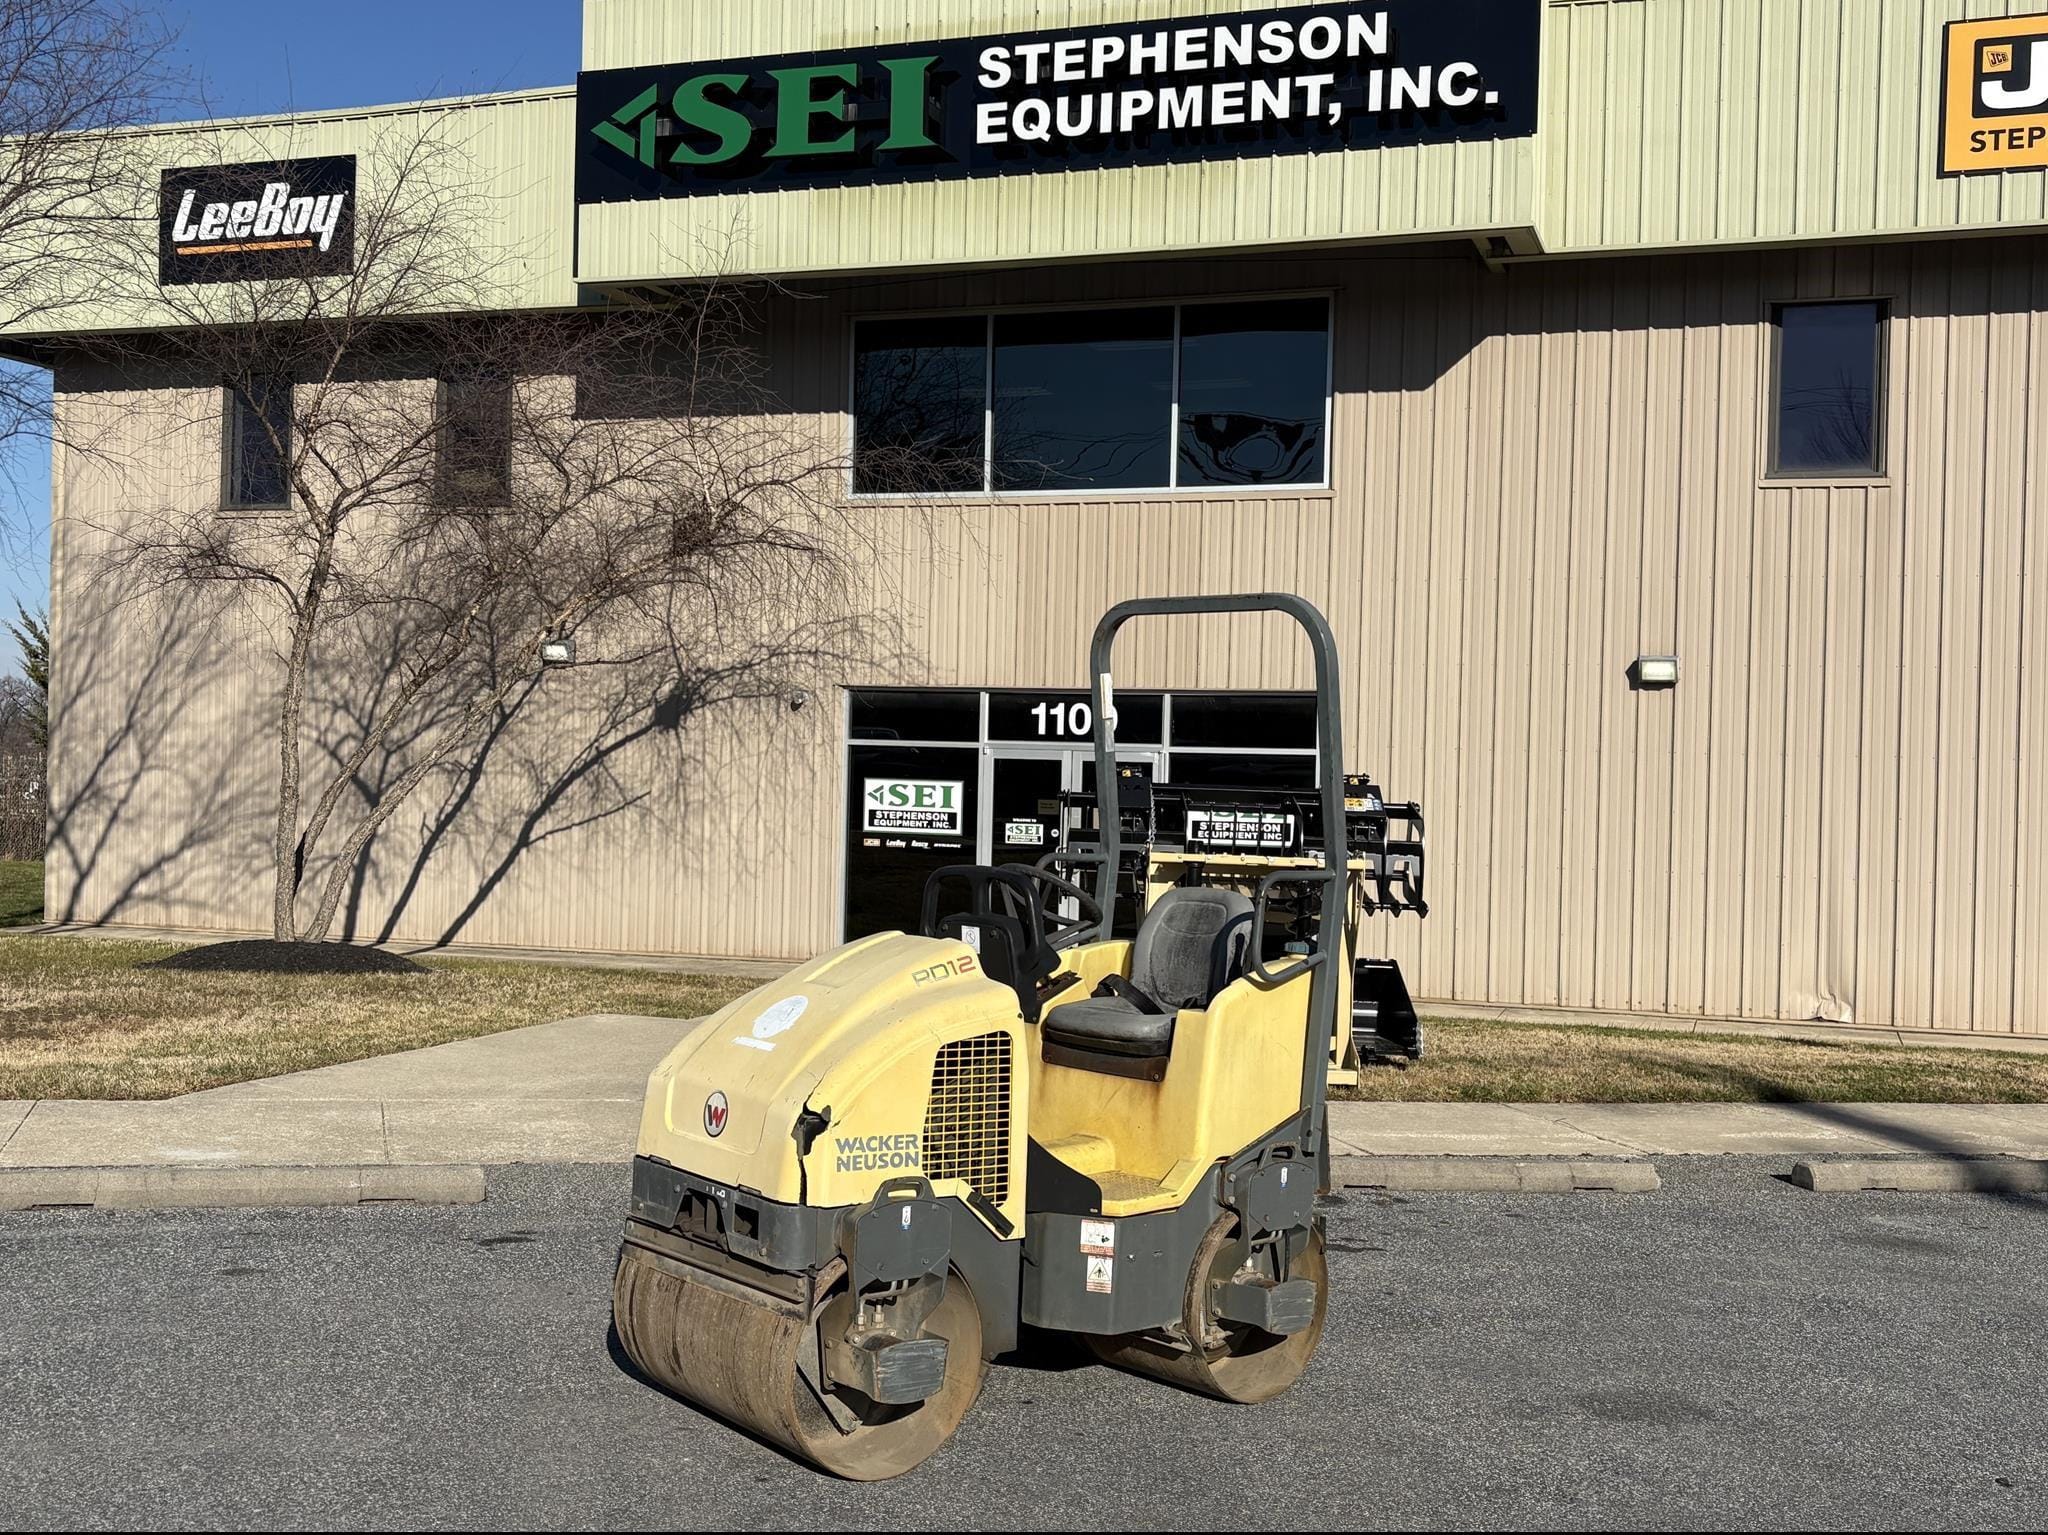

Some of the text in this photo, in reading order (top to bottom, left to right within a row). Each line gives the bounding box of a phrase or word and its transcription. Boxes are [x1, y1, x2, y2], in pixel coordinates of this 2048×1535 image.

[978, 12, 1388, 89] STEPHENSON
[1990, 52, 2007, 65] JCB
[669, 55, 940, 165] SEI
[976, 61, 1499, 144] EQUIPMENT, INC.
[1970, 126, 2046, 153] STEP
[172, 182, 344, 252] LeeBoy
[1031, 702, 1118, 736] 110
[888, 783, 955, 809] SEI
[873, 819, 952, 829] EQUIPMENT, INC.
[875, 810, 949, 821] STEPHENSON
[1014, 824, 1041, 836] SEI
[707, 1103, 726, 1128] W
[834, 1133, 920, 1155] WACKER
[836, 1150, 920, 1173] NEUSON
